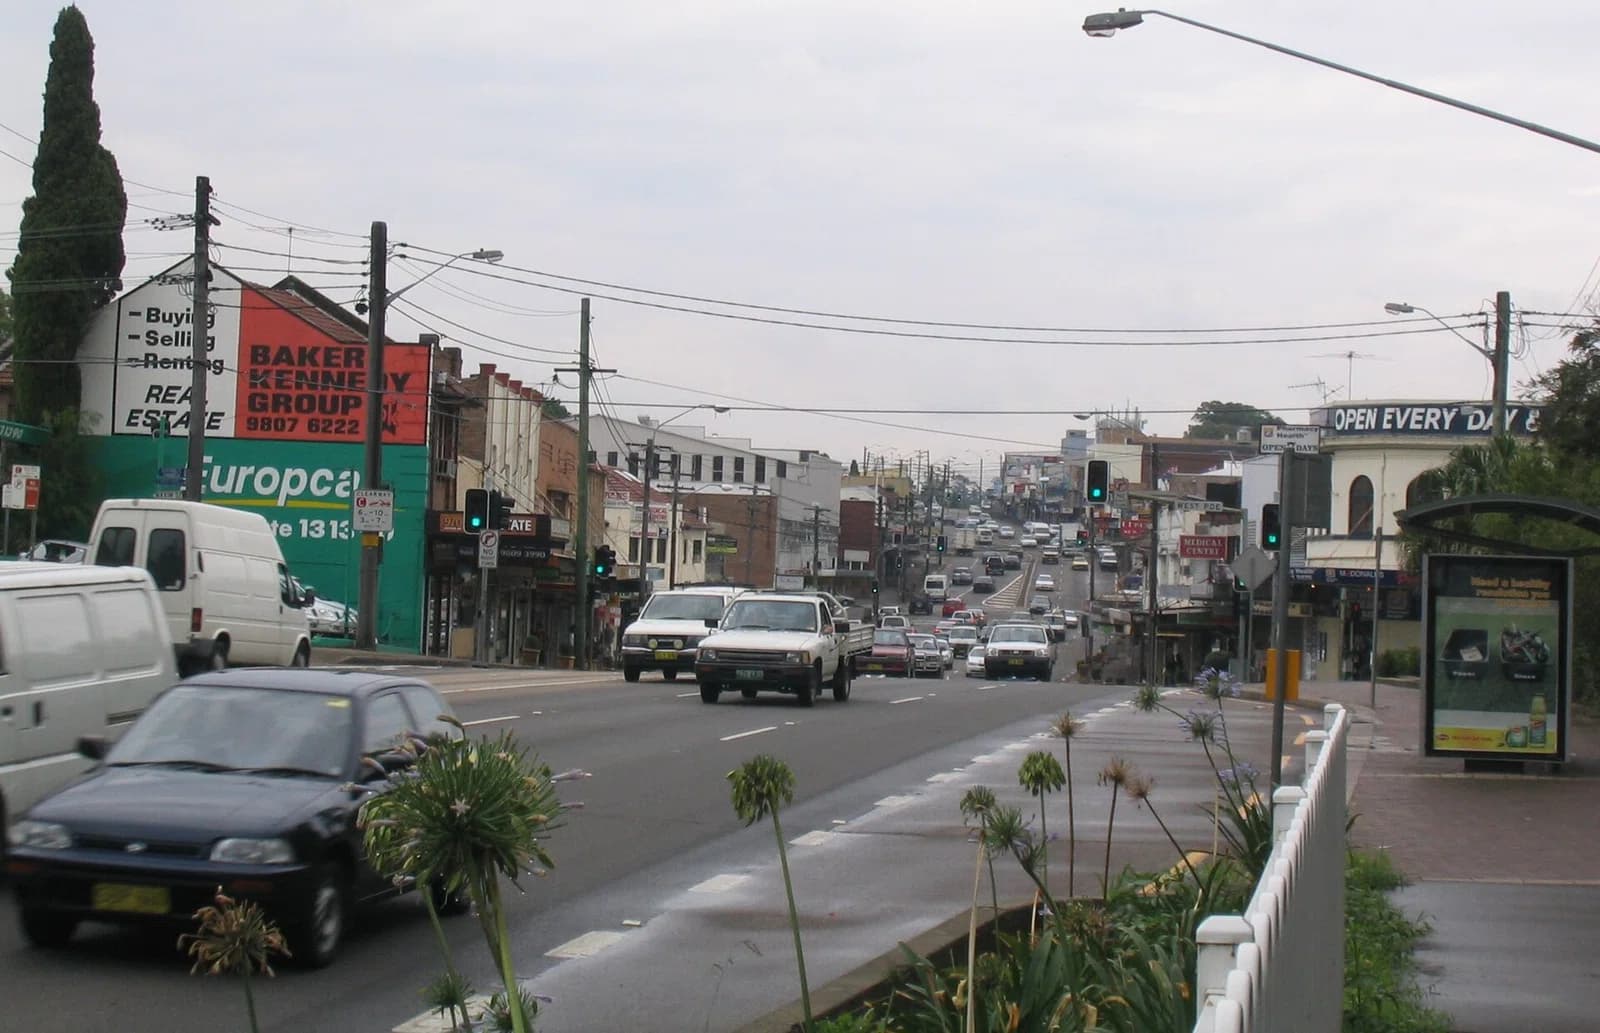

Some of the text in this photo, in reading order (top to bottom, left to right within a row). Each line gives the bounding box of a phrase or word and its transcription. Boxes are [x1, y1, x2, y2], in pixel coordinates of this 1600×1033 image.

[145, 330, 216, 352] Sellig
[143, 353, 225, 376] Rentg
[250, 345, 365, 369] BAKER
[249, 368, 411, 394] KENNEY
[144, 384, 208, 405] REA
[247, 392, 363, 416] GROUP
[125, 408, 226, 431] ESTAE
[246, 417, 361, 435] 9807 6222
[1335, 407, 1378, 431] OPEN
[1382, 407, 1460, 431] EVERY
[201, 455, 361, 507] uropca
[300, 520, 325, 539] 13
